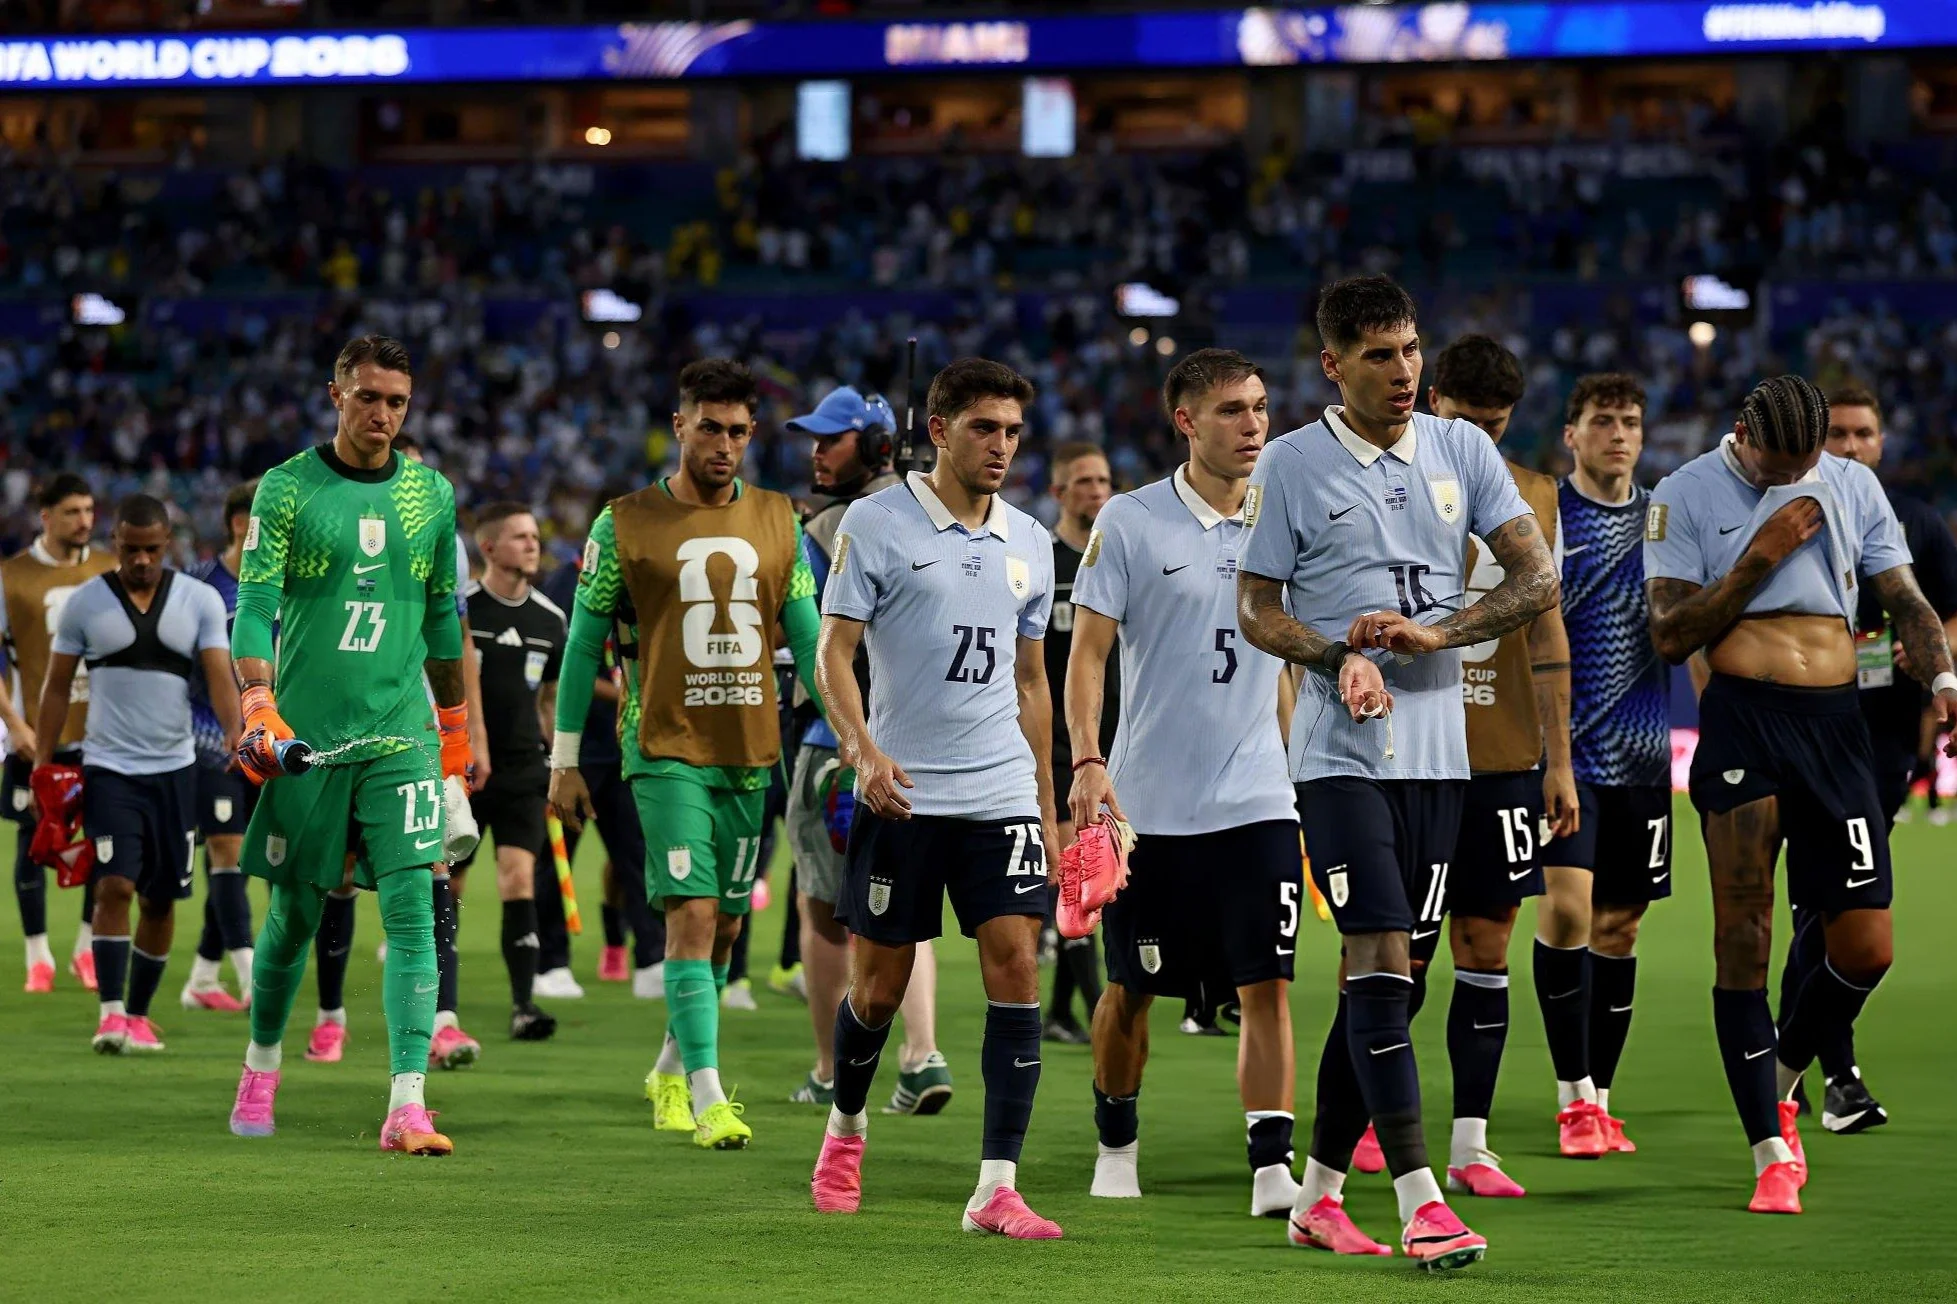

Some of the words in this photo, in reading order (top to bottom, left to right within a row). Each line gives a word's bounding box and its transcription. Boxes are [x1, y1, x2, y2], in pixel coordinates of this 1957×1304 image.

[53, 40, 190, 80] WORLD
[191, 38, 271, 79] CUP
[270, 35, 408, 77] 2026
[337, 600, 388, 653] 23
[707, 641, 742, 655] FIFA
[684, 672, 735, 686] WORLD
[737, 671, 763, 685] CUP
[944, 624, 996, 685] 25
[1212, 628, 1238, 684] 5
[1467, 668, 1497, 682] CUP
[684, 686, 764, 707] 2026
[1463, 684, 1496, 706] 26
[396, 779, 441, 834] 23
[1005, 823, 1048, 876] 25
[1497, 807, 1533, 863] 15
[1846, 817, 1874, 871] 9
[1279, 881, 1298, 937] 5
